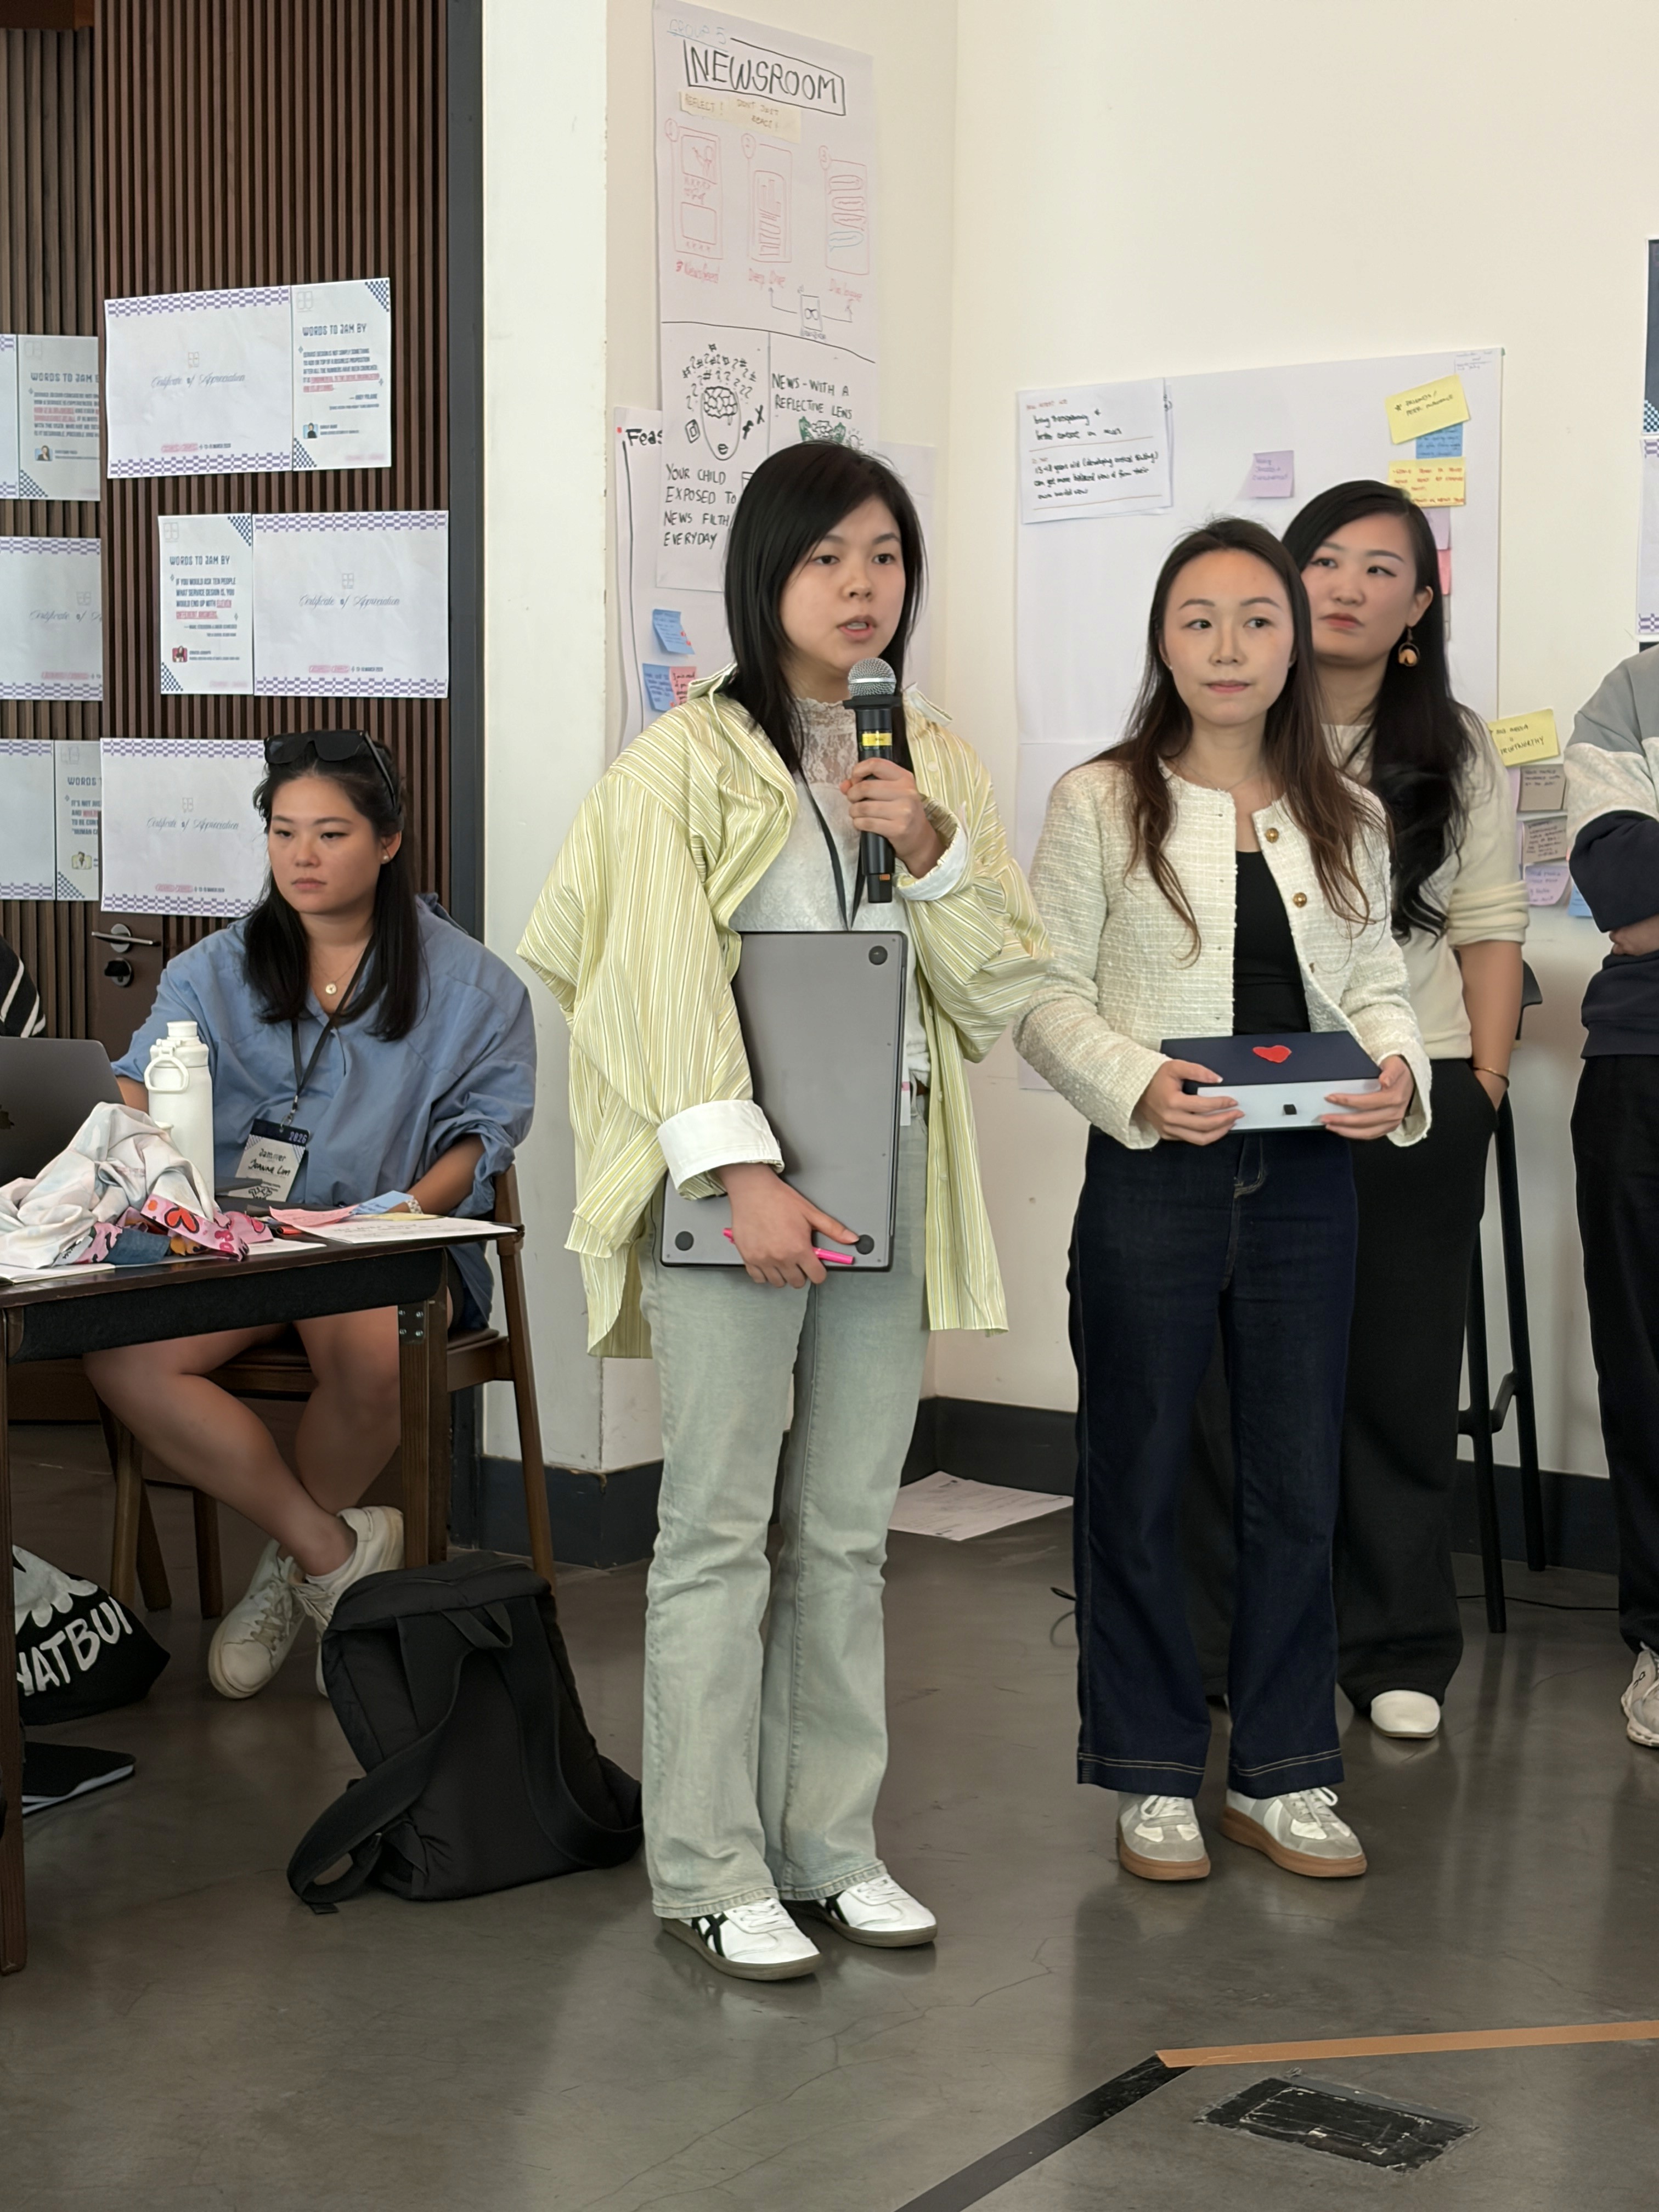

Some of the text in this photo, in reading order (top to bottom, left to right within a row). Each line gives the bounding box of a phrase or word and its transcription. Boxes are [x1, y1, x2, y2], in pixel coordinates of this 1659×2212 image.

[690, 46, 837, 104] NEWSROOM
[303, 323, 367, 336] WORDS TO JAM BY
[31, 373, 60, 382] WORDS
[63, 373, 72, 382] TO
[75, 374, 93, 383] JAM
[842, 385, 849, 396] A
[831, 405, 853, 420] LENS
[665, 463, 726, 485] YOUR CHILD
[665, 486, 716, 504] EXPOSED
[664, 510, 693, 526] NEWS
[663, 532, 718, 550] EVERYDAY
[170, 555, 230, 566] WORDS TO JAM BY
[221, 577, 236, 585] PEOPLE
[299, 594, 400, 610] Certificate of Appreciation
[67, 777, 97, 786] WORDS
[182, 818, 190, 832] of
[289, 1131, 308, 1144] 2026
